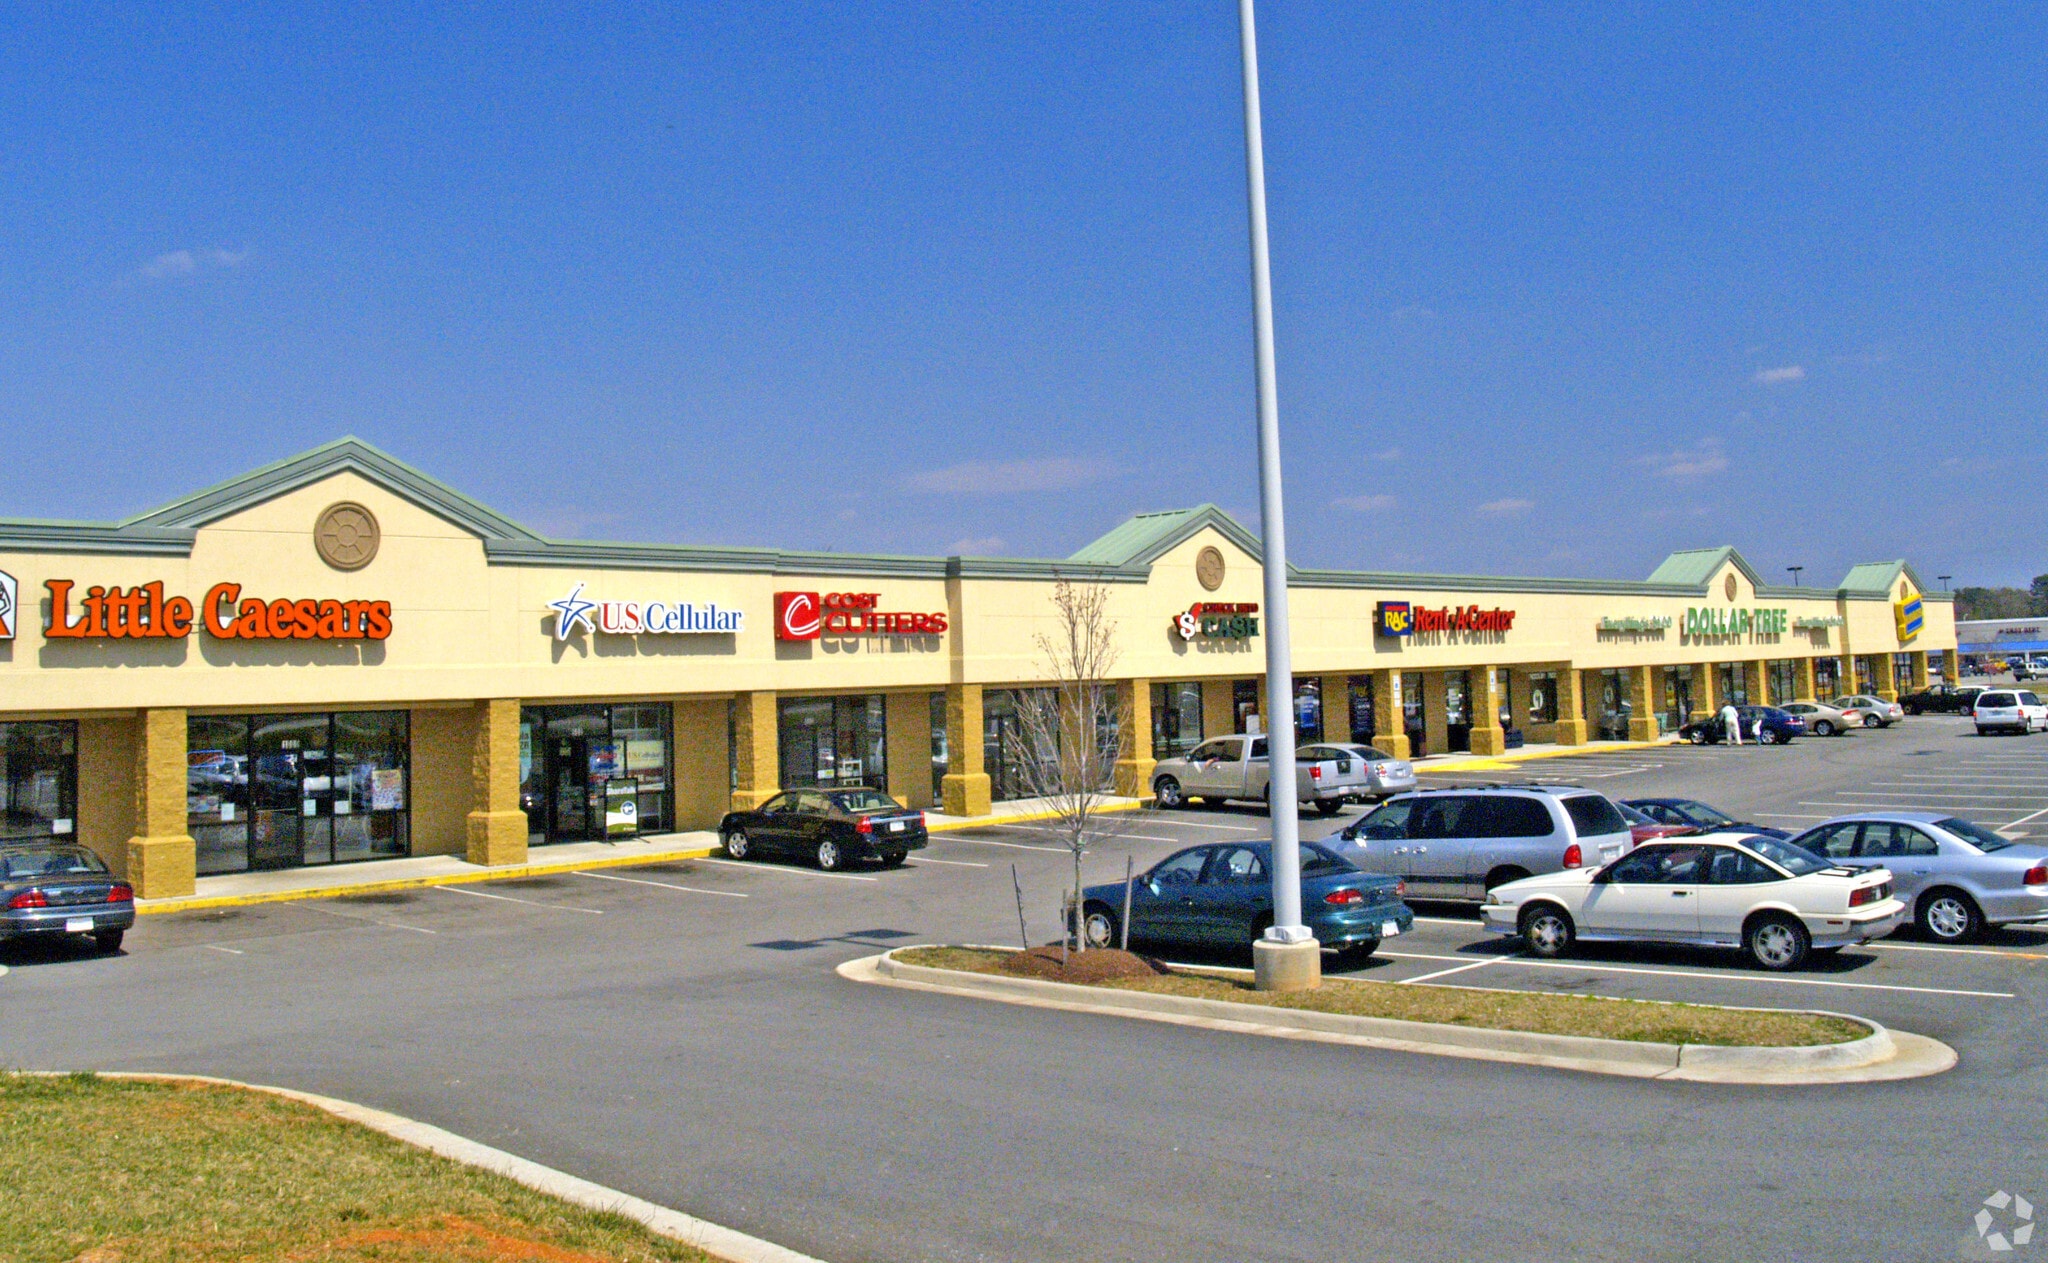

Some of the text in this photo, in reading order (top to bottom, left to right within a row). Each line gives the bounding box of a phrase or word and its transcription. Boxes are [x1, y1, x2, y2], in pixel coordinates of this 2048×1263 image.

[43, 579, 393, 640] Little Caesars
[825, 592, 882, 609] COST
[600, 602, 743, 631] U.S. Cellular
[825, 611, 948, 634] CUTTERS
[1385, 611, 1409, 632] RAC
[1684, 607, 1749, 634] DOLLAR
[1753, 608, 1788, 633] TREE
